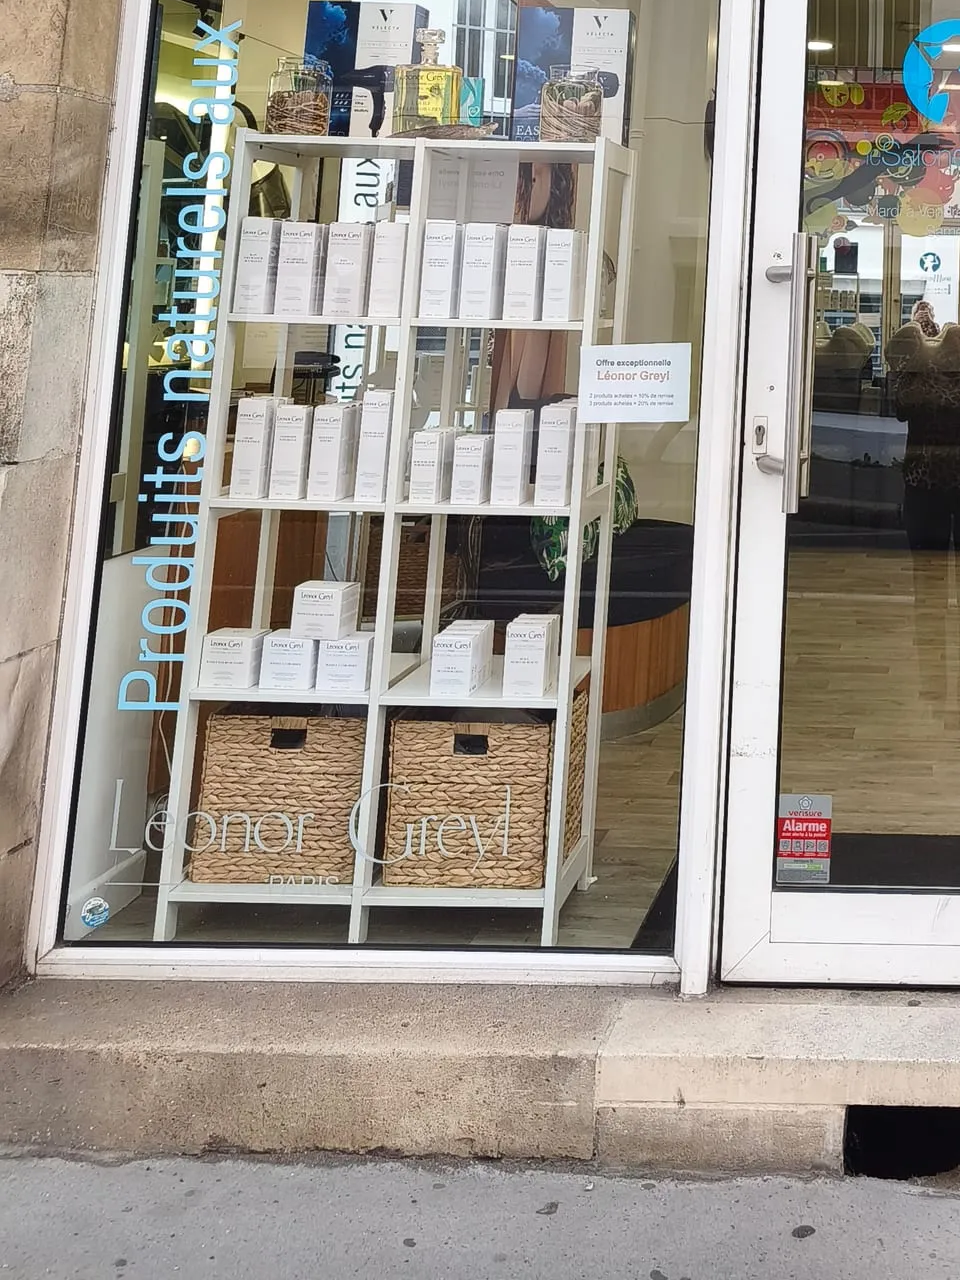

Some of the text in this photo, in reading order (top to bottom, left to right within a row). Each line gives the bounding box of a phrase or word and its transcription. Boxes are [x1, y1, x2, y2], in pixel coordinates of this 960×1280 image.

[188, 19, 243, 125] aux
[516, 125, 541, 136] EAS
[159, 151, 231, 401] naturels
[616, 359, 672, 368] exceptionnelle
[597, 370, 670, 382] Léonor Greyl
[118, 431, 206, 710] Produits
[508, 630, 545, 640] Leonor Greyl
[454, 640, 471, 650] Greyl
[109, 779, 511, 873] Leonor Greyl
[783, 820, 827, 831] Alarme
